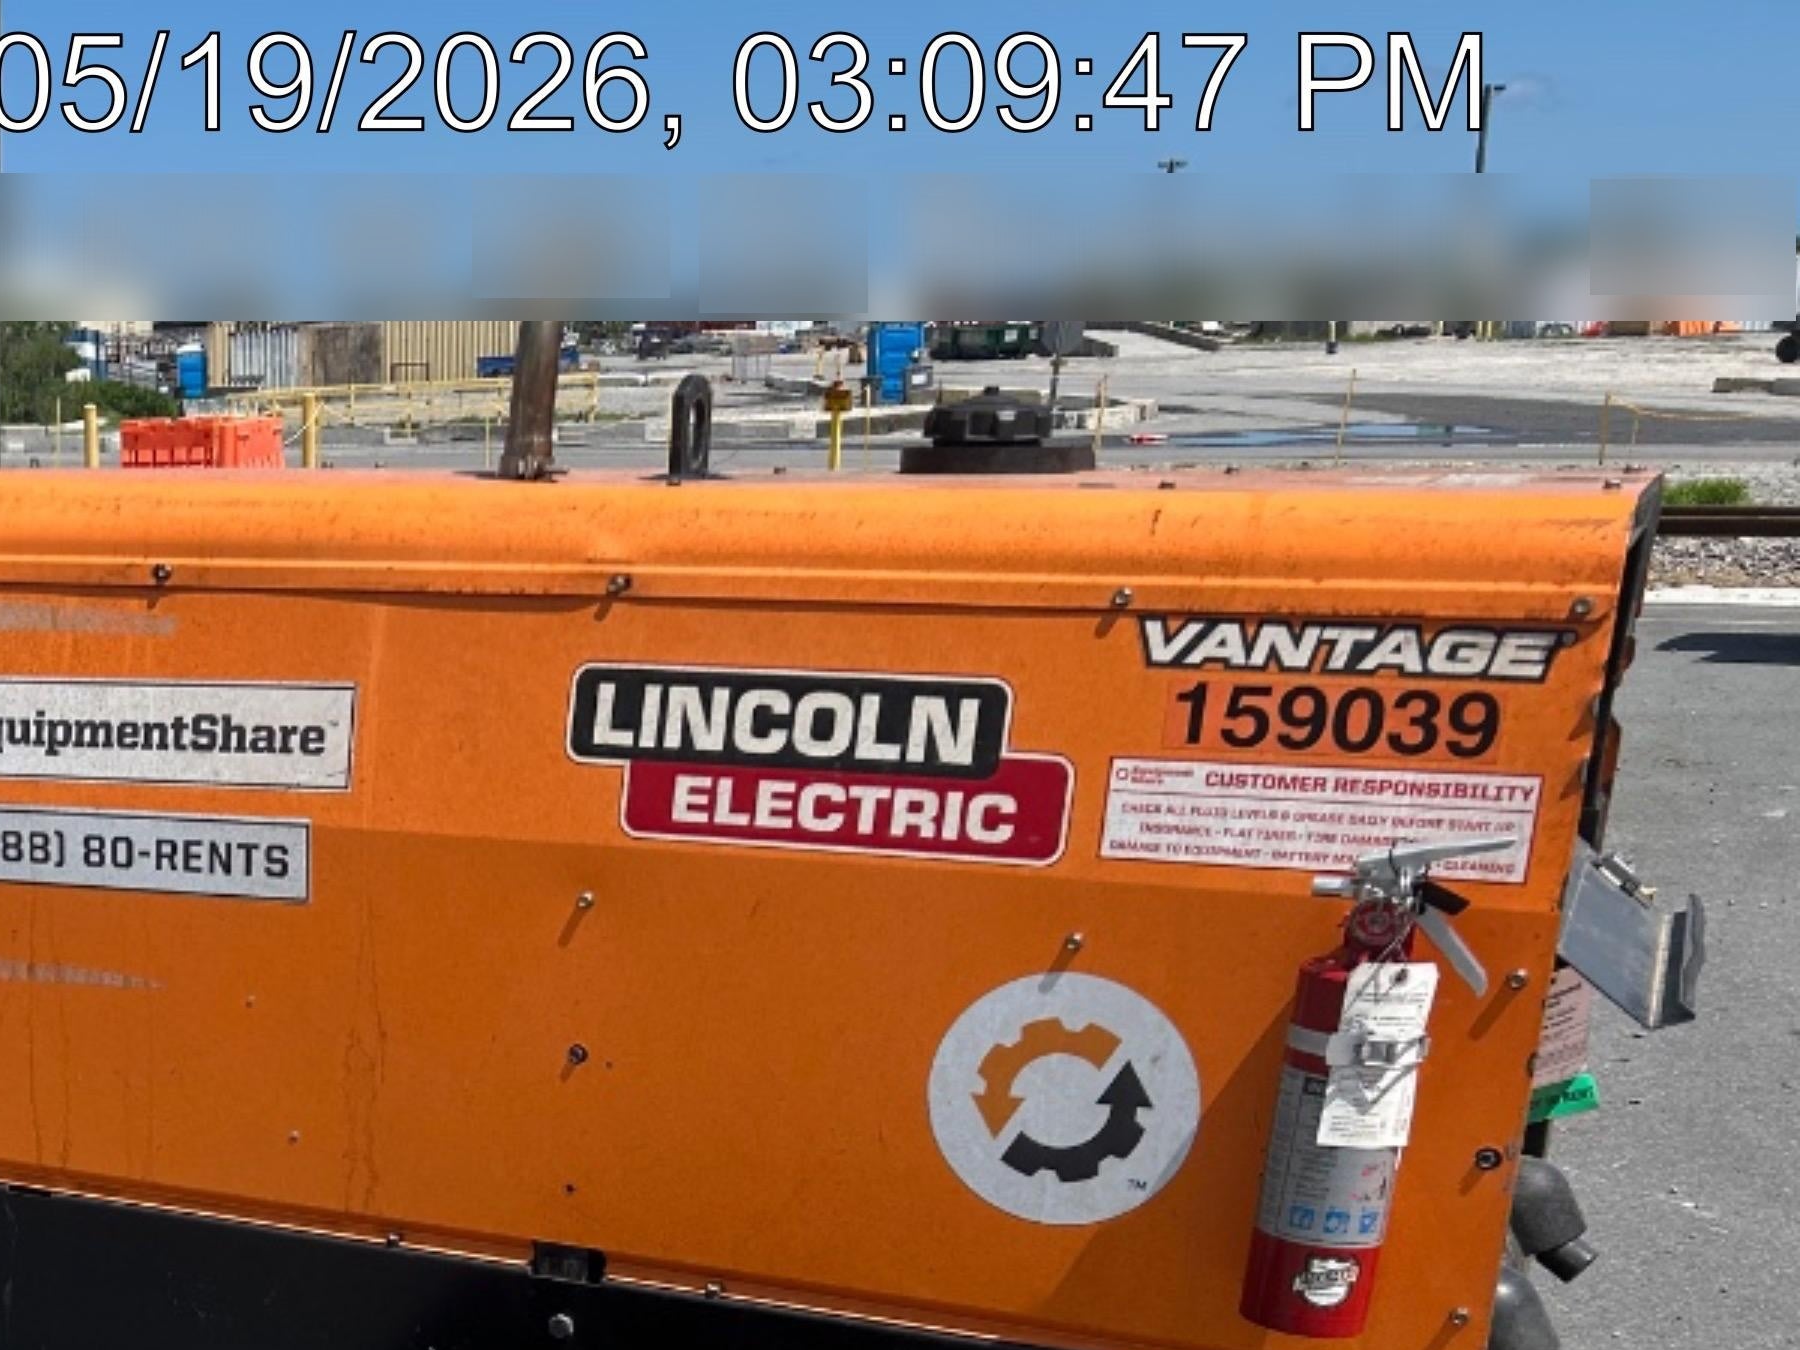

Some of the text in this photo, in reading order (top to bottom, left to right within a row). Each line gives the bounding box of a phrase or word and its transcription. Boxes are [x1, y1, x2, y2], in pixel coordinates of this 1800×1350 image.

[1141, 617, 1560, 680] VANTAGE
[592, 682, 980, 766] LINCOLN
[1175, 681, 1498, 757] 159039
[671, 775, 1017, 844] ELECTRIC
[1204, 770, 1327, 792] CUSTOMER
[1333, 776, 1535, 801] RESPONSIBILITY
[83, 835, 289, 878] 80-RENTS
